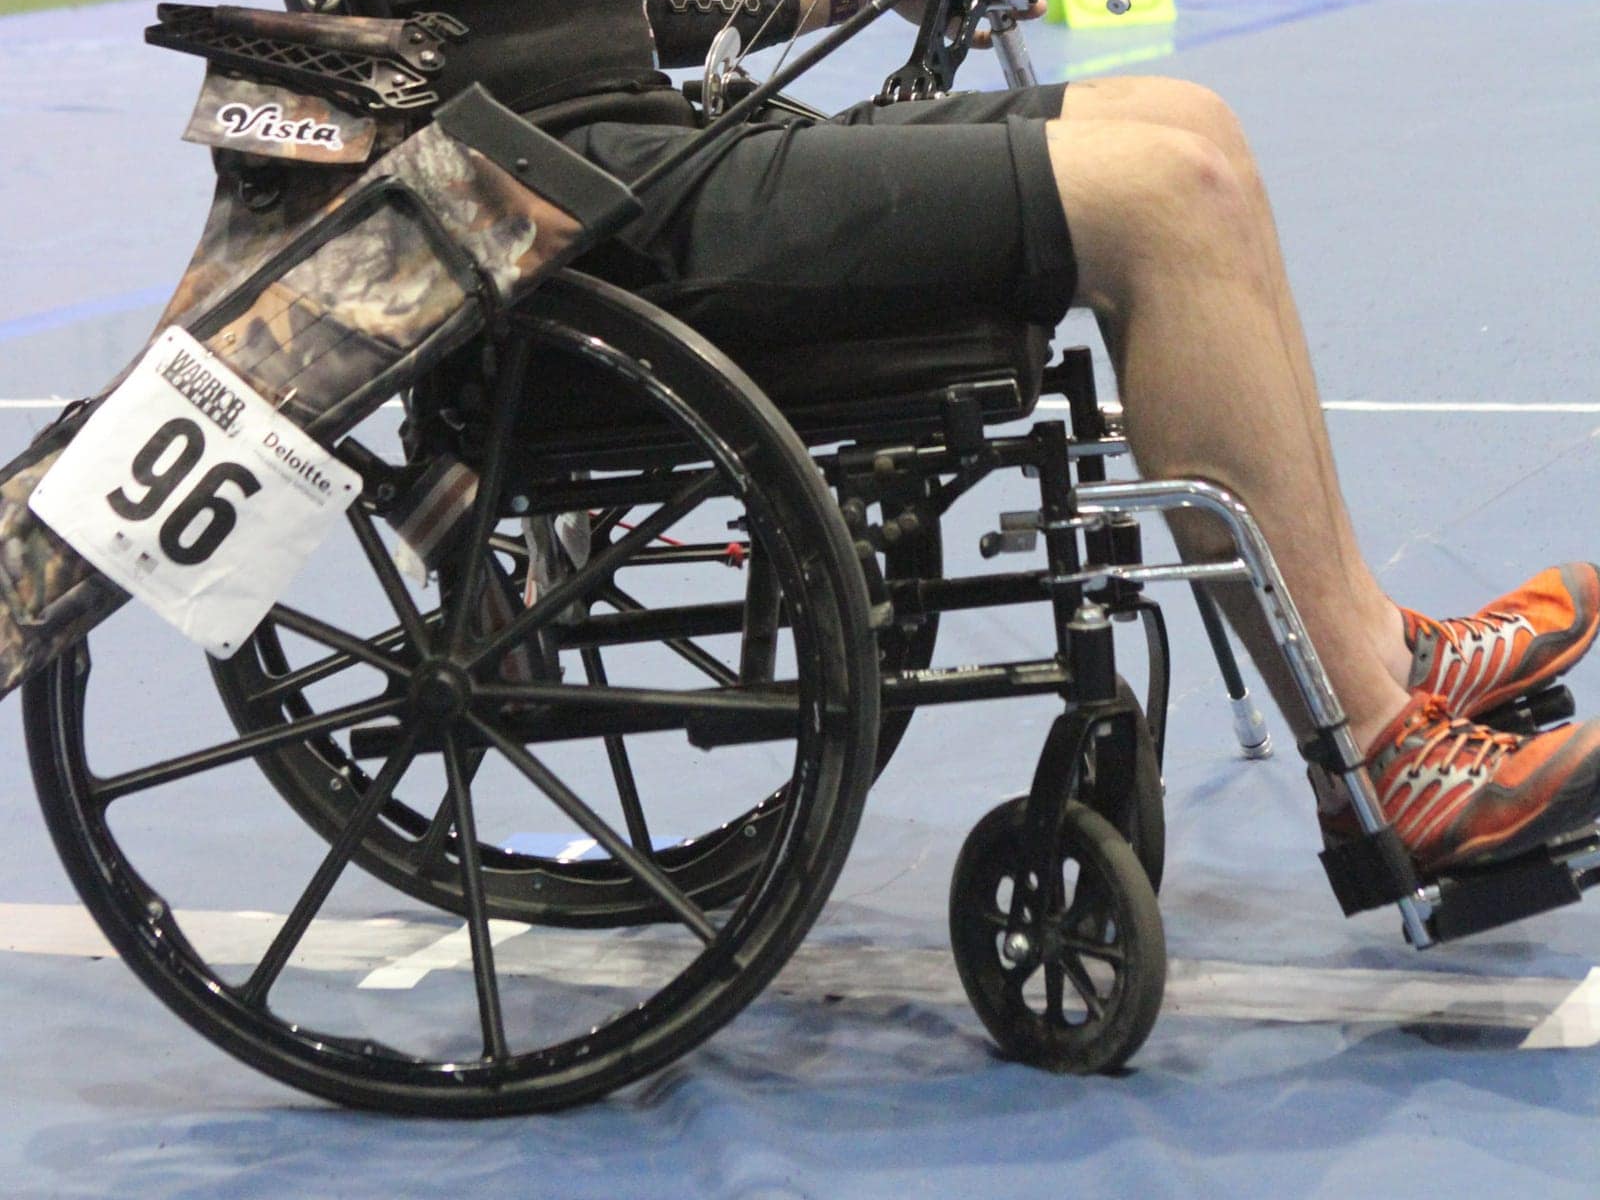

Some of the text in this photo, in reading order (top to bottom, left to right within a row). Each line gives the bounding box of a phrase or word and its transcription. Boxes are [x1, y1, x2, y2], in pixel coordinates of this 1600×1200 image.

[218, 103, 341, 142] Vista
[166, 348, 246, 421] WARRIOR
[106, 417, 262, 566] 96
